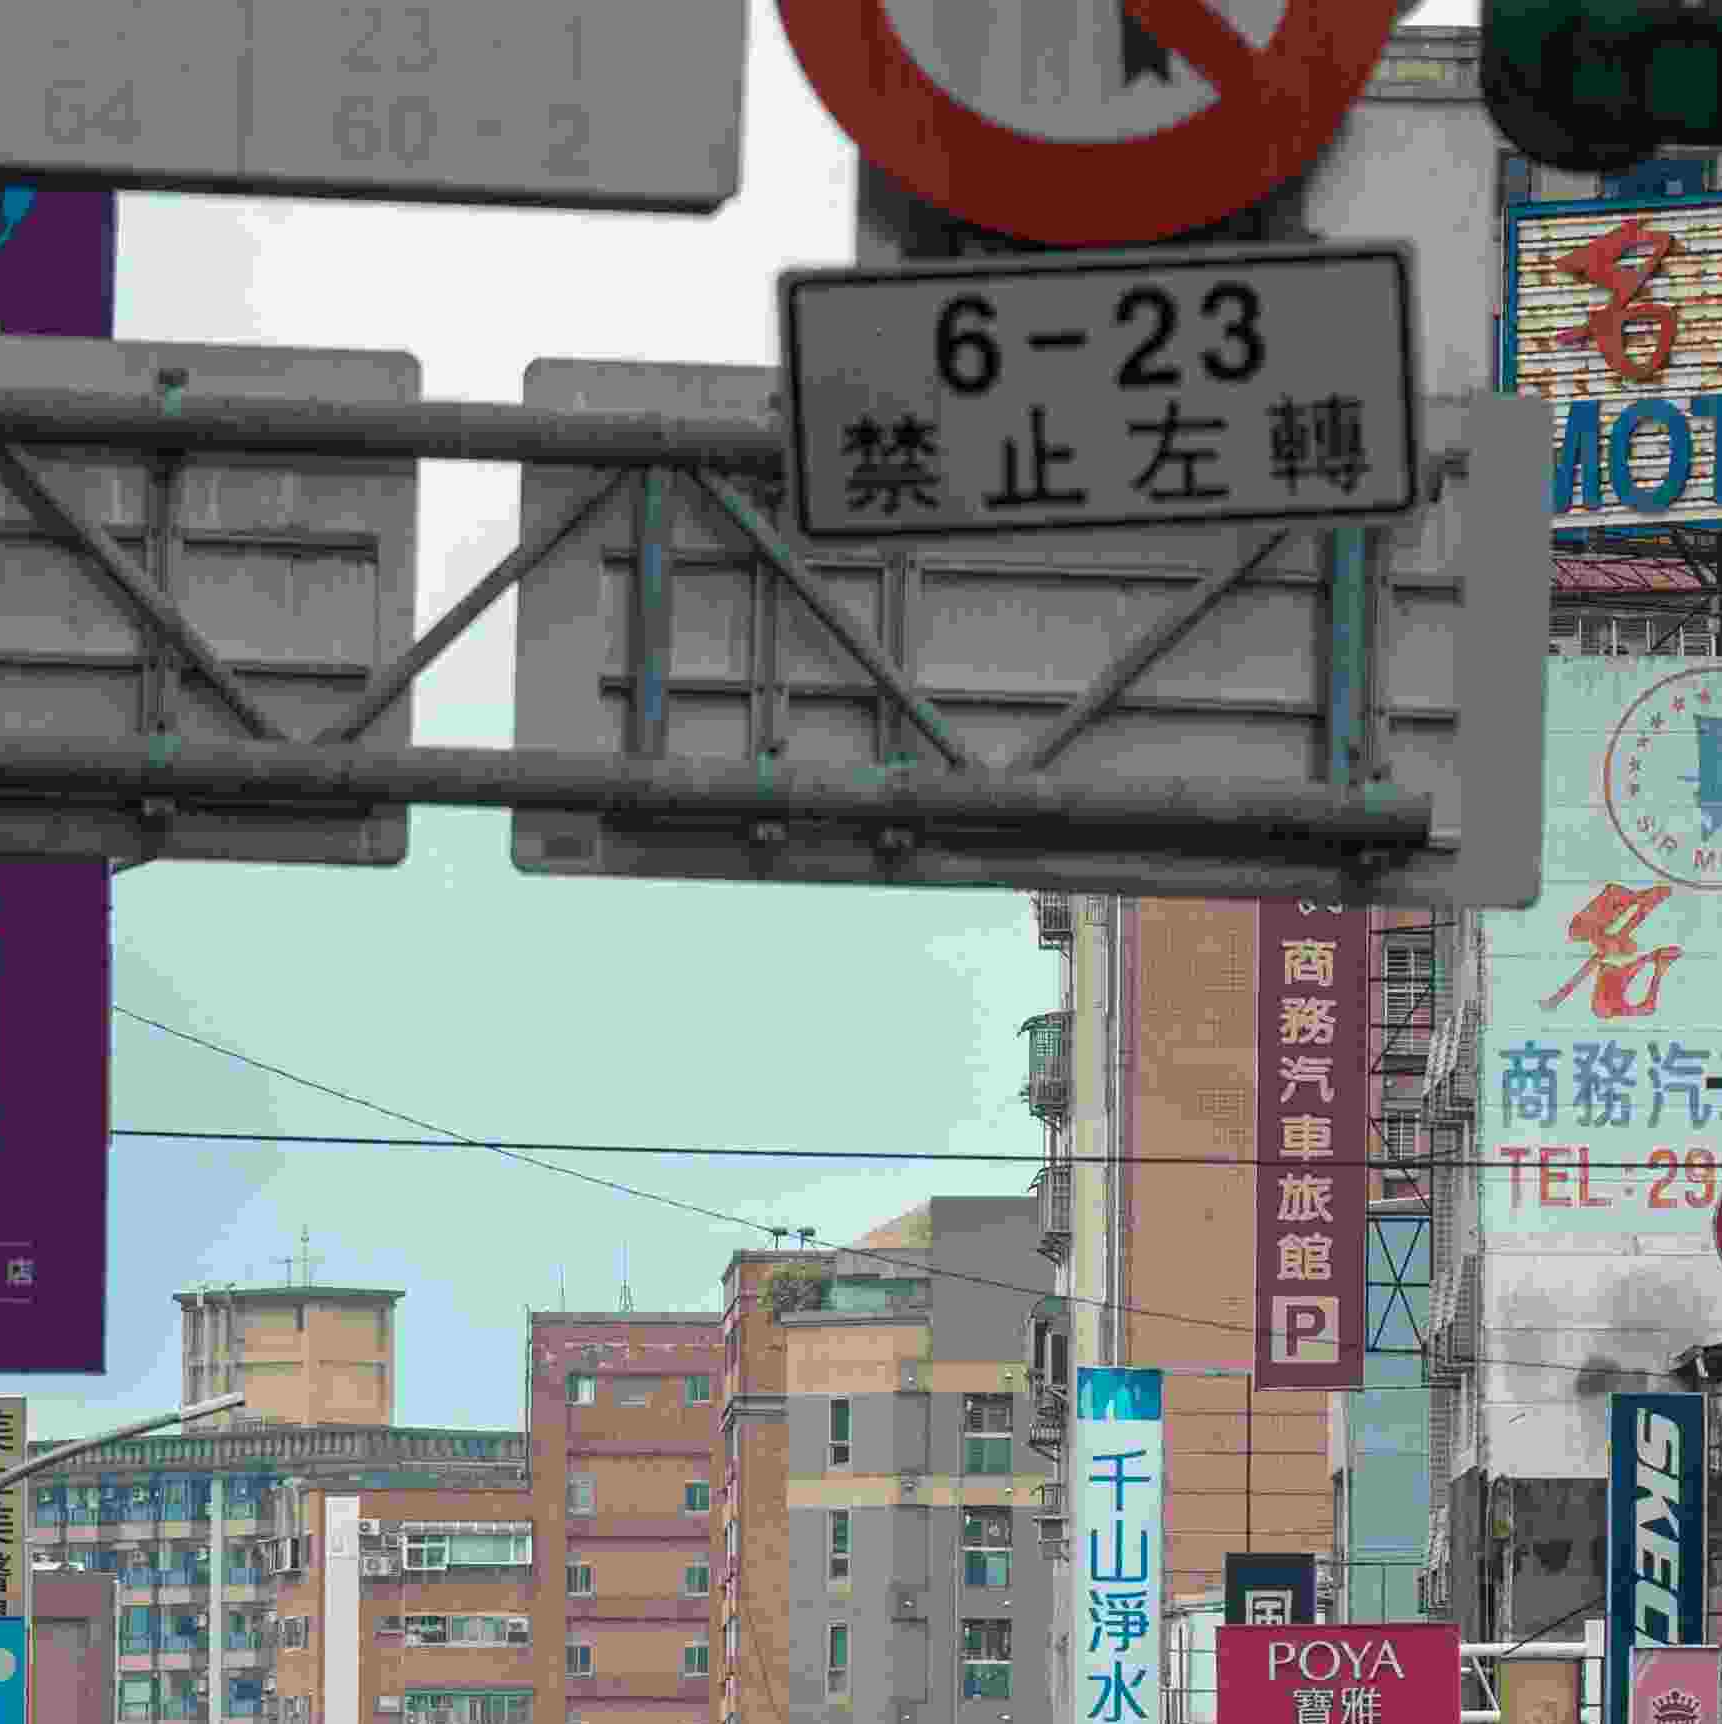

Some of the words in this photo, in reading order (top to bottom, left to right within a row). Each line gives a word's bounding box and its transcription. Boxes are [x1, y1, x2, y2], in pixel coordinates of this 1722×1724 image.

[934, 282, 1267, 396] 6-23
[839, 393, 1371, 515] 禁止左轉
[1276, 900, 1339, 1282] 商務汽車旅館
[1086, 1449, 1152, 1723] 千山淨水
[1267, 1638, 1406, 1682] POYA
